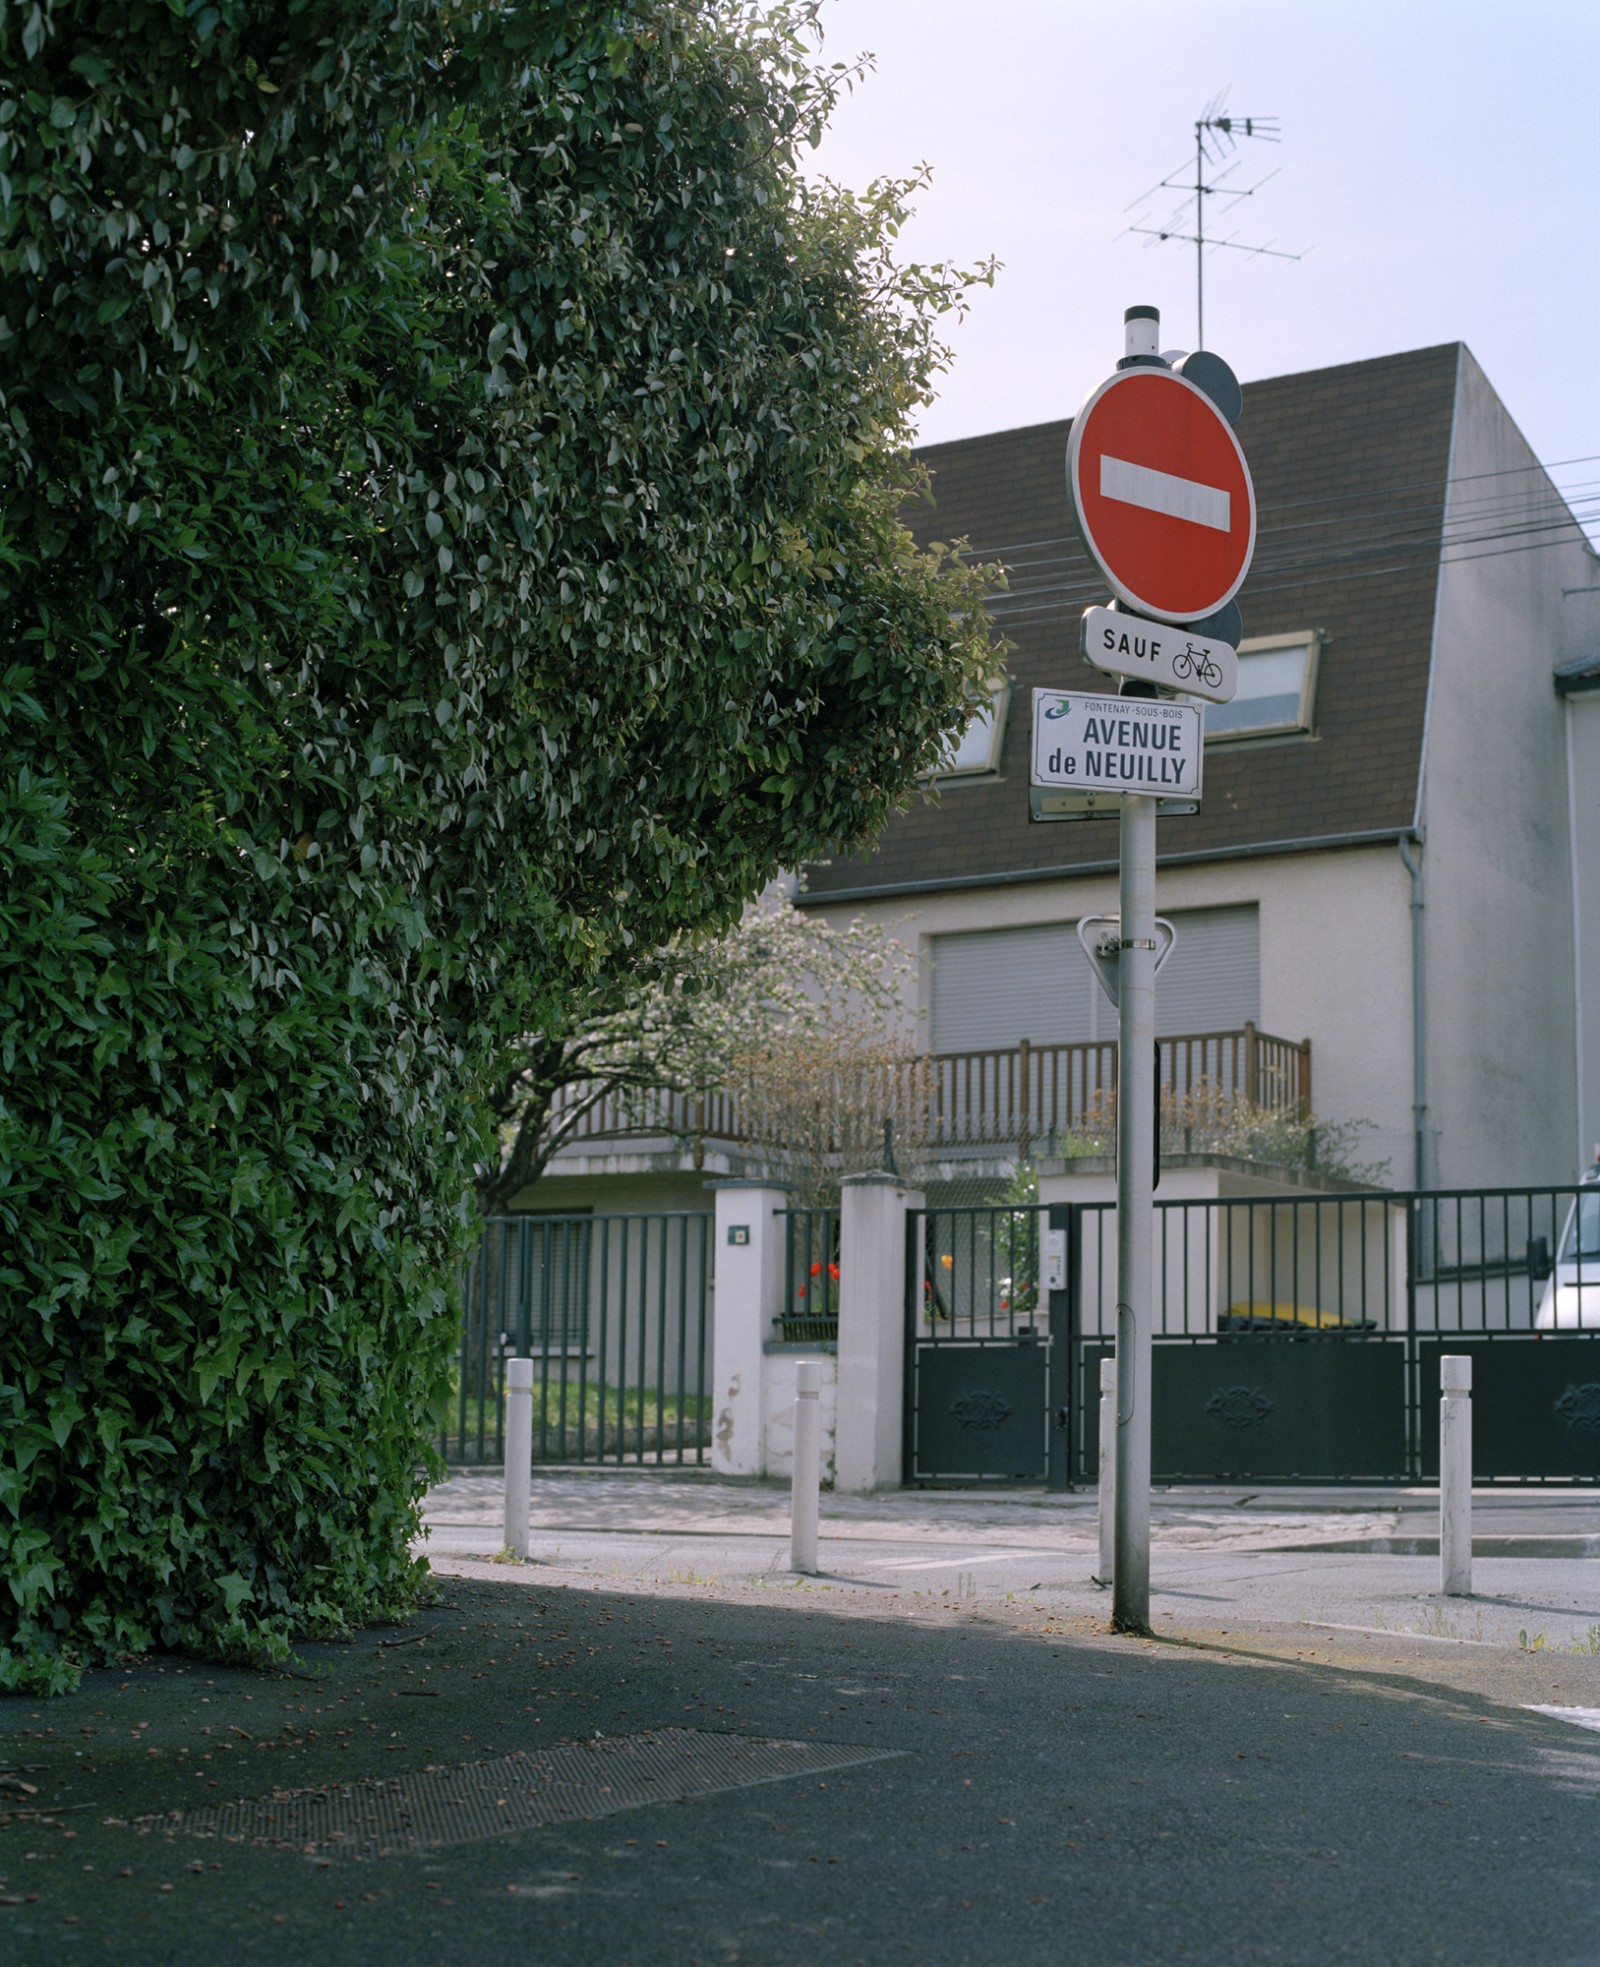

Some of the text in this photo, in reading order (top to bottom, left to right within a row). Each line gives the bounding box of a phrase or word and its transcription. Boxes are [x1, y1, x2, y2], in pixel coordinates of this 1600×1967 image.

[1103, 629, 1161, 661] SAUF
[1083, 718, 1181, 751] AVENUE
[1049, 748, 1186, 784] de NEUILLY
